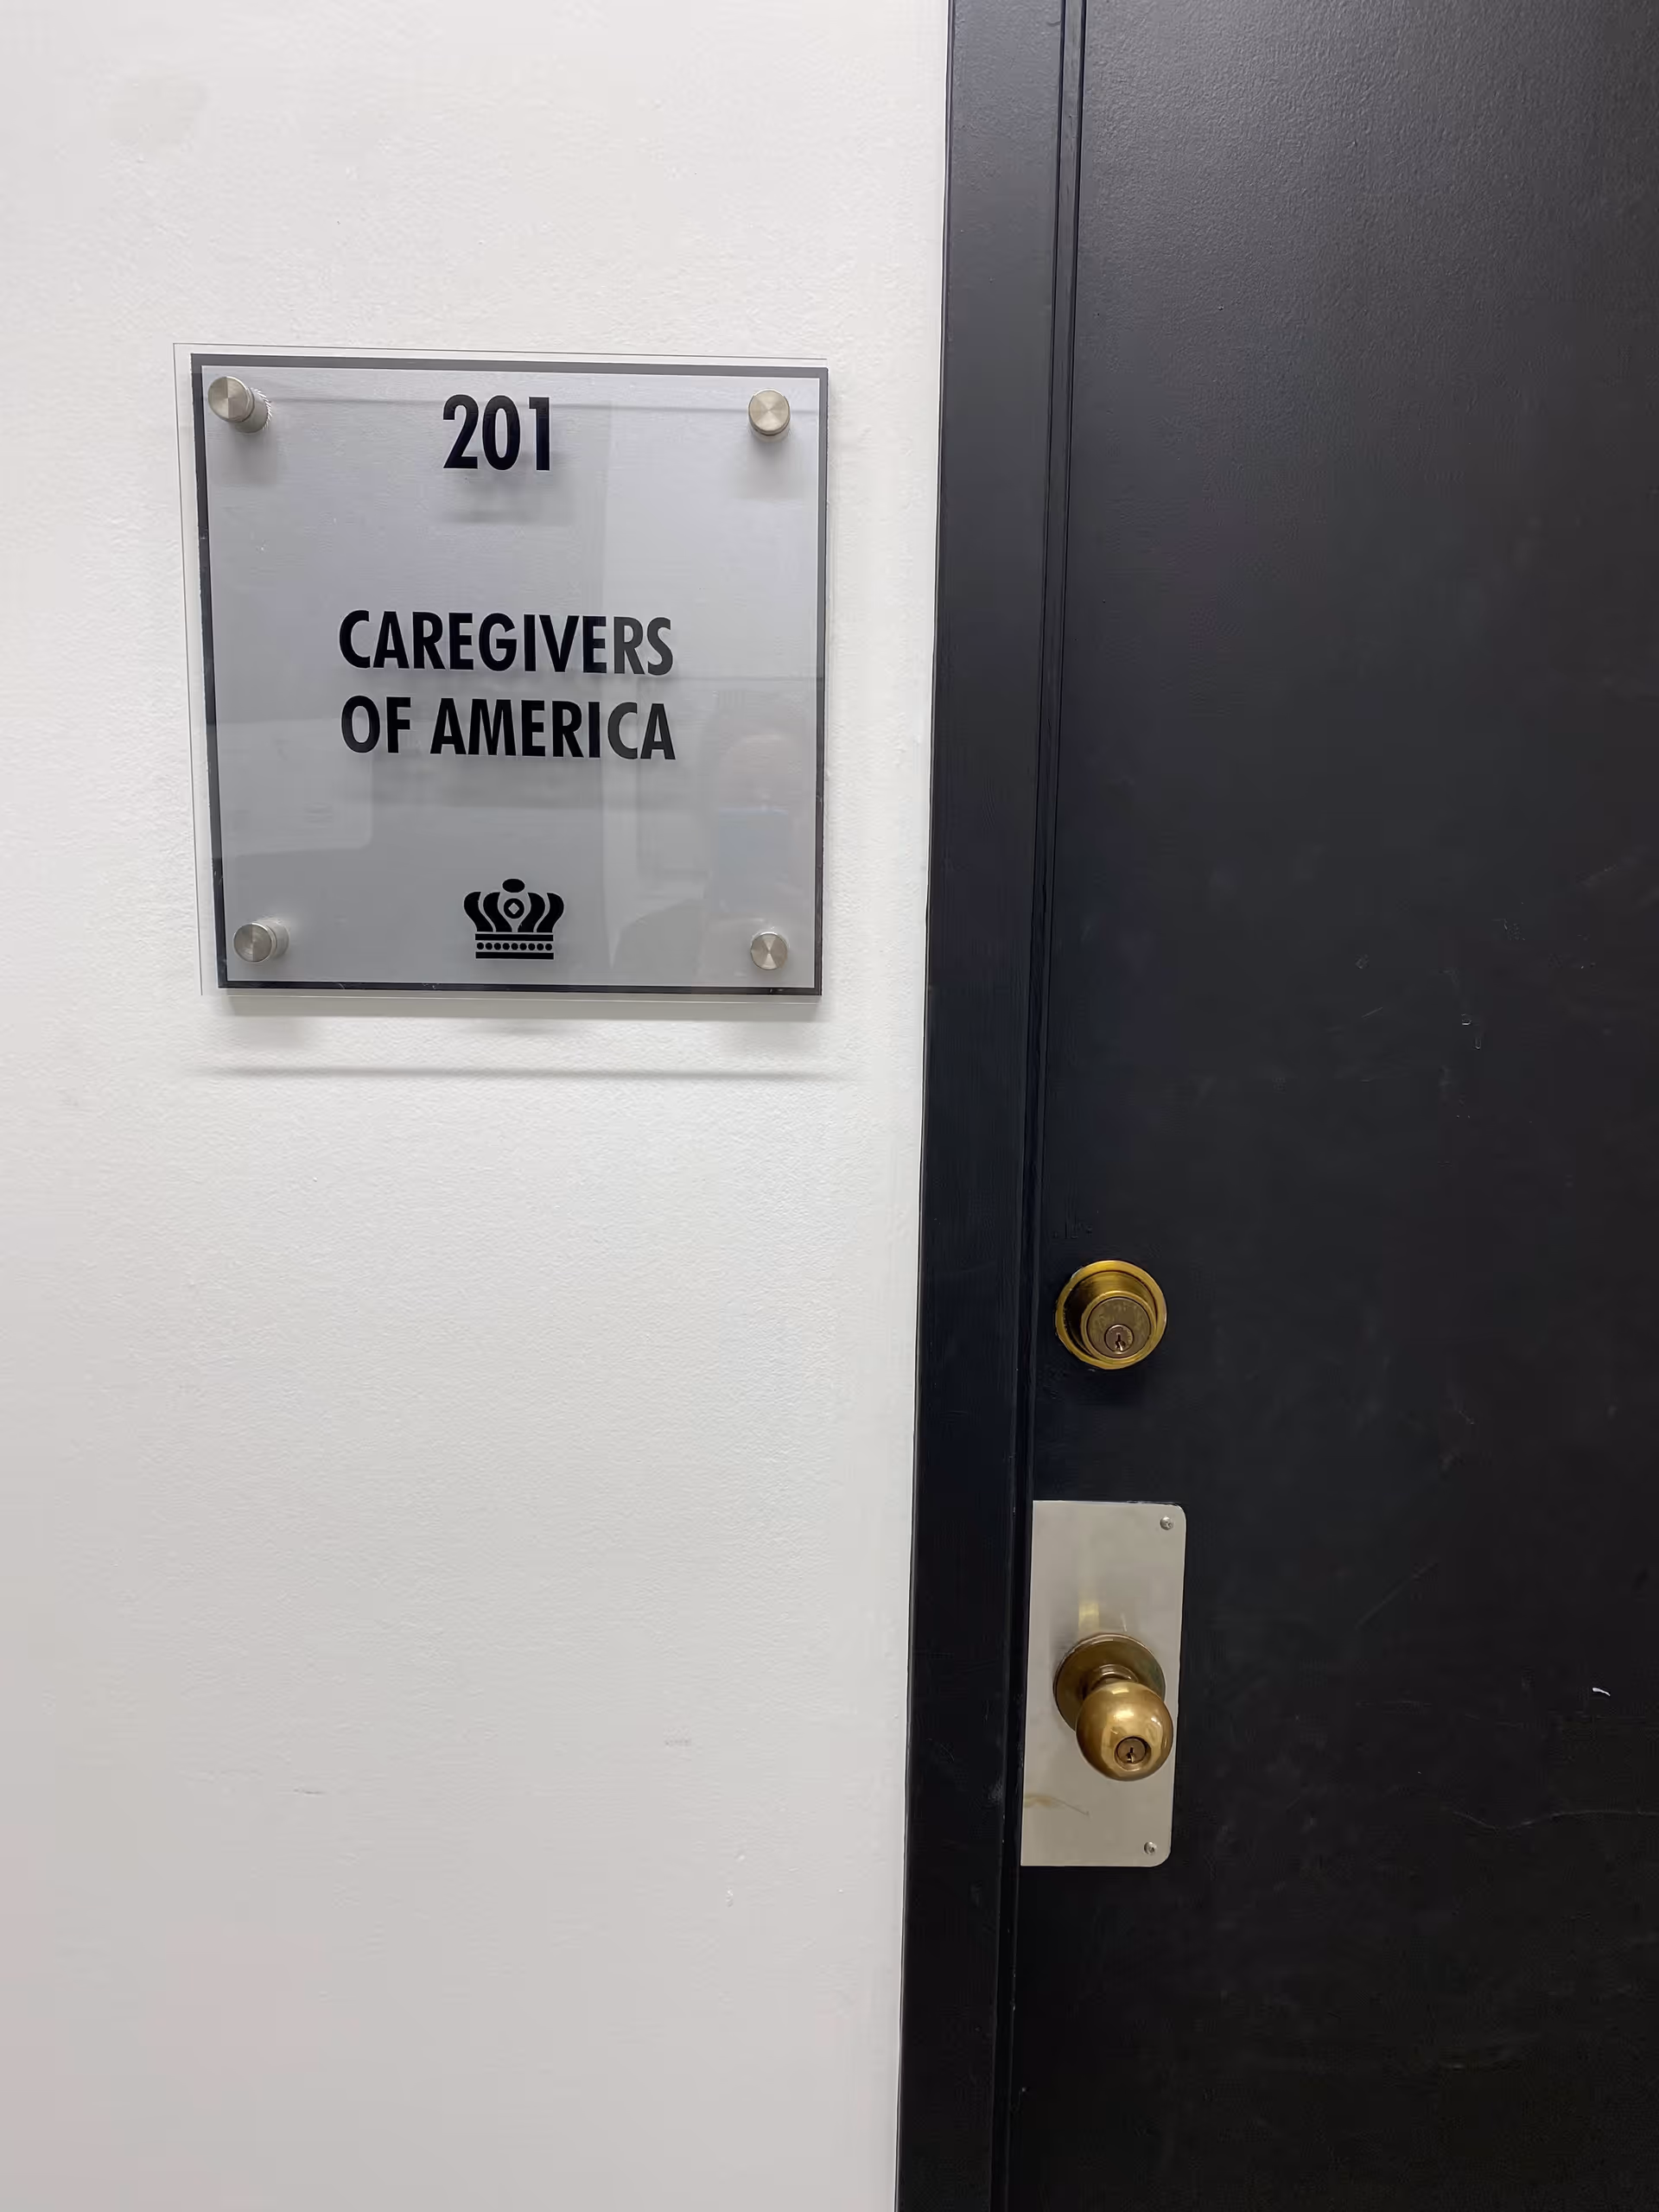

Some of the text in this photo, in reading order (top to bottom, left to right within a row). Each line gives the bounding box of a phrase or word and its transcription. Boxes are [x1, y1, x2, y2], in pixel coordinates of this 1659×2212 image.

[443, 394, 550, 471] 201
[340, 610, 674, 677] CAREGIVERS
[341, 696, 677, 760] OF AMERICA
